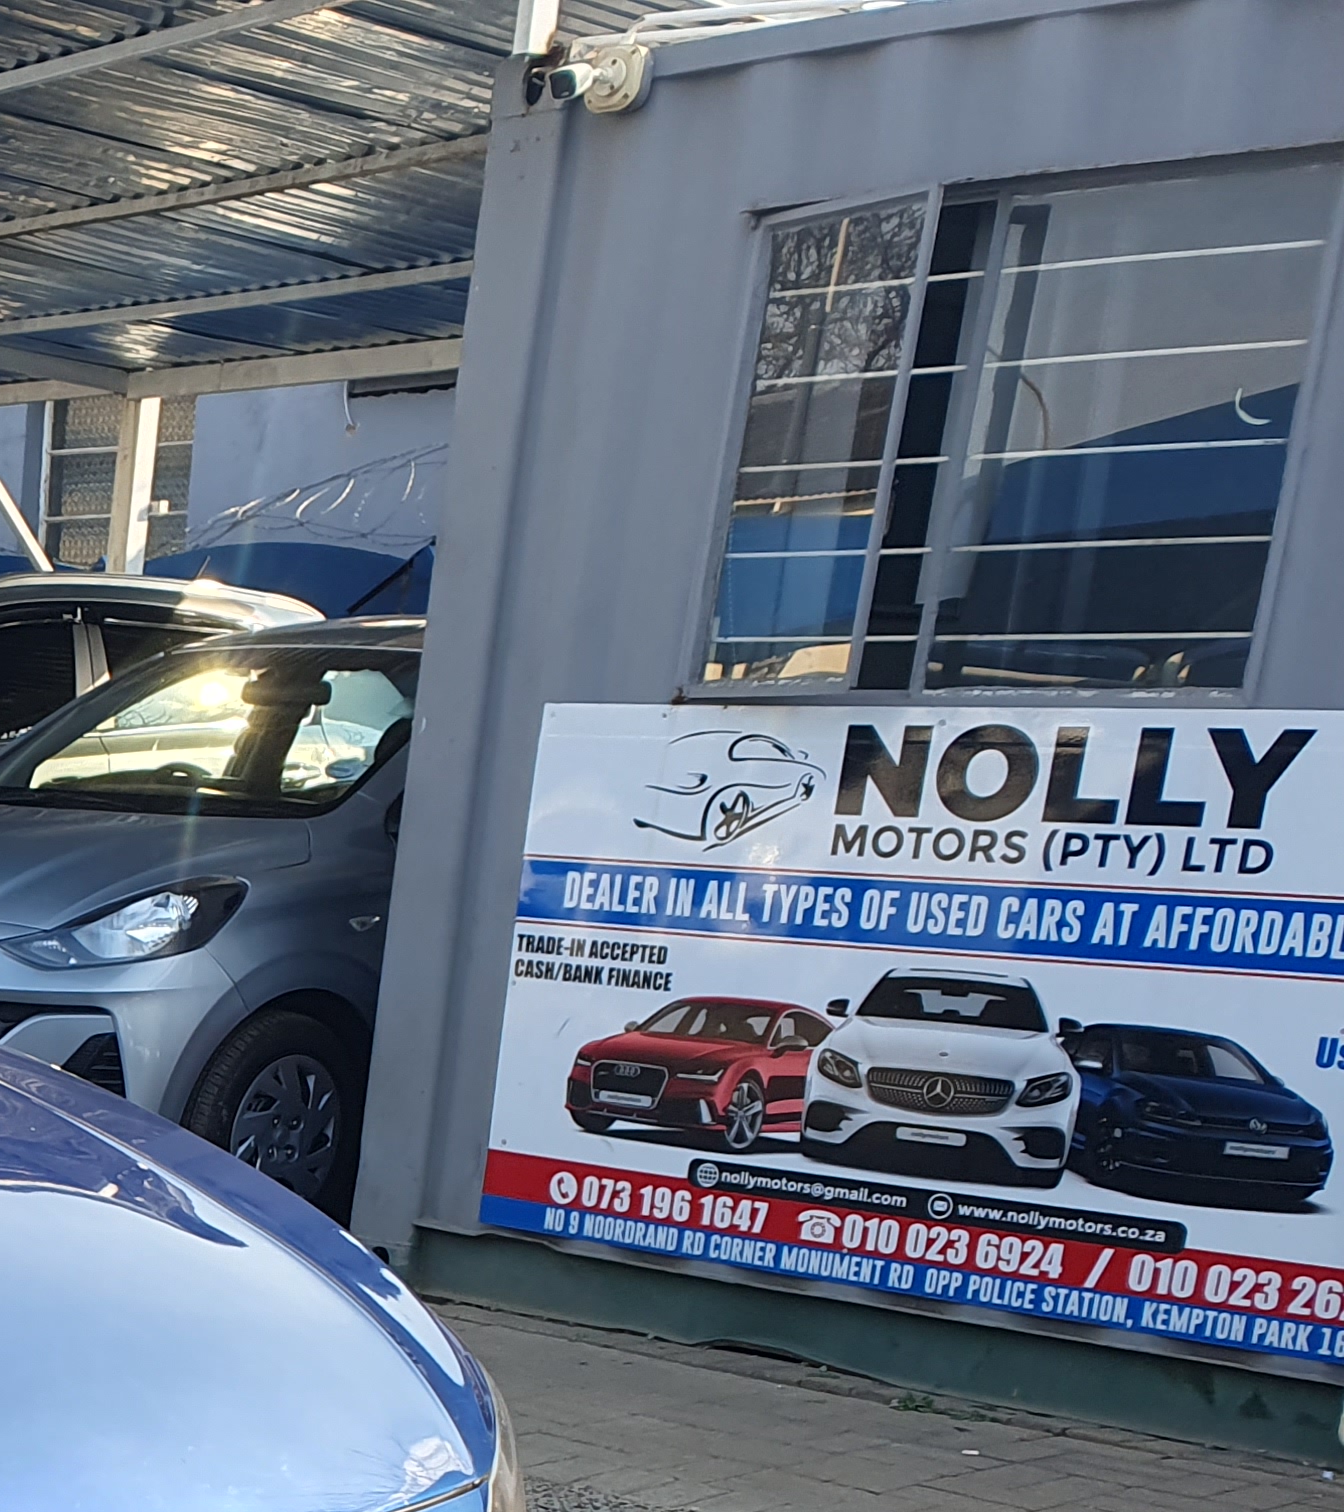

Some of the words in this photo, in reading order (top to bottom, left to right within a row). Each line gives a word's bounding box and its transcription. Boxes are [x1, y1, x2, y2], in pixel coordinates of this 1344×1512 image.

[833, 723, 1318, 829] NOLLY
[830, 823, 1029, 865] MOTORS
[1042, 828, 1166, 876] (PTY)
[1181, 836, 1275, 875] LTD
[563, 871, 658, 915] DEALER
[665, 878, 696, 917] IN
[699, 880, 750, 922] ALL
[762, 883, 852, 928] TYPES
[859, 888, 901, 931] OF
[906, 891, 988, 937] USED
[996, 896, 1085, 943] CARS
[1091, 902, 1140, 946] AT
[514, 959, 605, 986] CASH/BANK
[608, 966, 673, 992] FINANCE
[516, 934, 585, 958] TRADE-IN
[589, 939, 669, 966] ACCEPTED
[581, 1175, 631, 1213] 073
[639, 1184, 692, 1222] 196
[699, 1194, 770, 1234] 1647
[720, 1170, 908, 1208] nollymotors@gmail.com
[957, 1201, 1167, 1243] www.nollymotors.co.za
[544, 1206, 565, 1232] NO
[568, 1211, 579, 1235] 9
[582, 1212, 678, 1252] NOORDRAND
[681, 1228, 705, 1256] RD
[709, 1233, 776, 1269] CORNER
[779, 1242, 886, 1285] MONUMENT
[887, 1263, 914, 1291] RD
[924, 1267, 962, 1298] OPP
[966, 1273, 1039, 1310] POLICE
[1041, 1286, 1133, 1329] STATION,
[1140, 1302, 1246, 1342] KEMPTON
[1250, 1317, 1314, 1353] PARK
[842, 1213, 900, 1255] 010
[905, 1223, 970, 1265] 023
[975, 1233, 1066, 1279] 6924
[1127, 1253, 1198, 1298] 010
[1203, 1264, 1282, 1310] 023
[1286, 1275, 1344, 1321] 26
